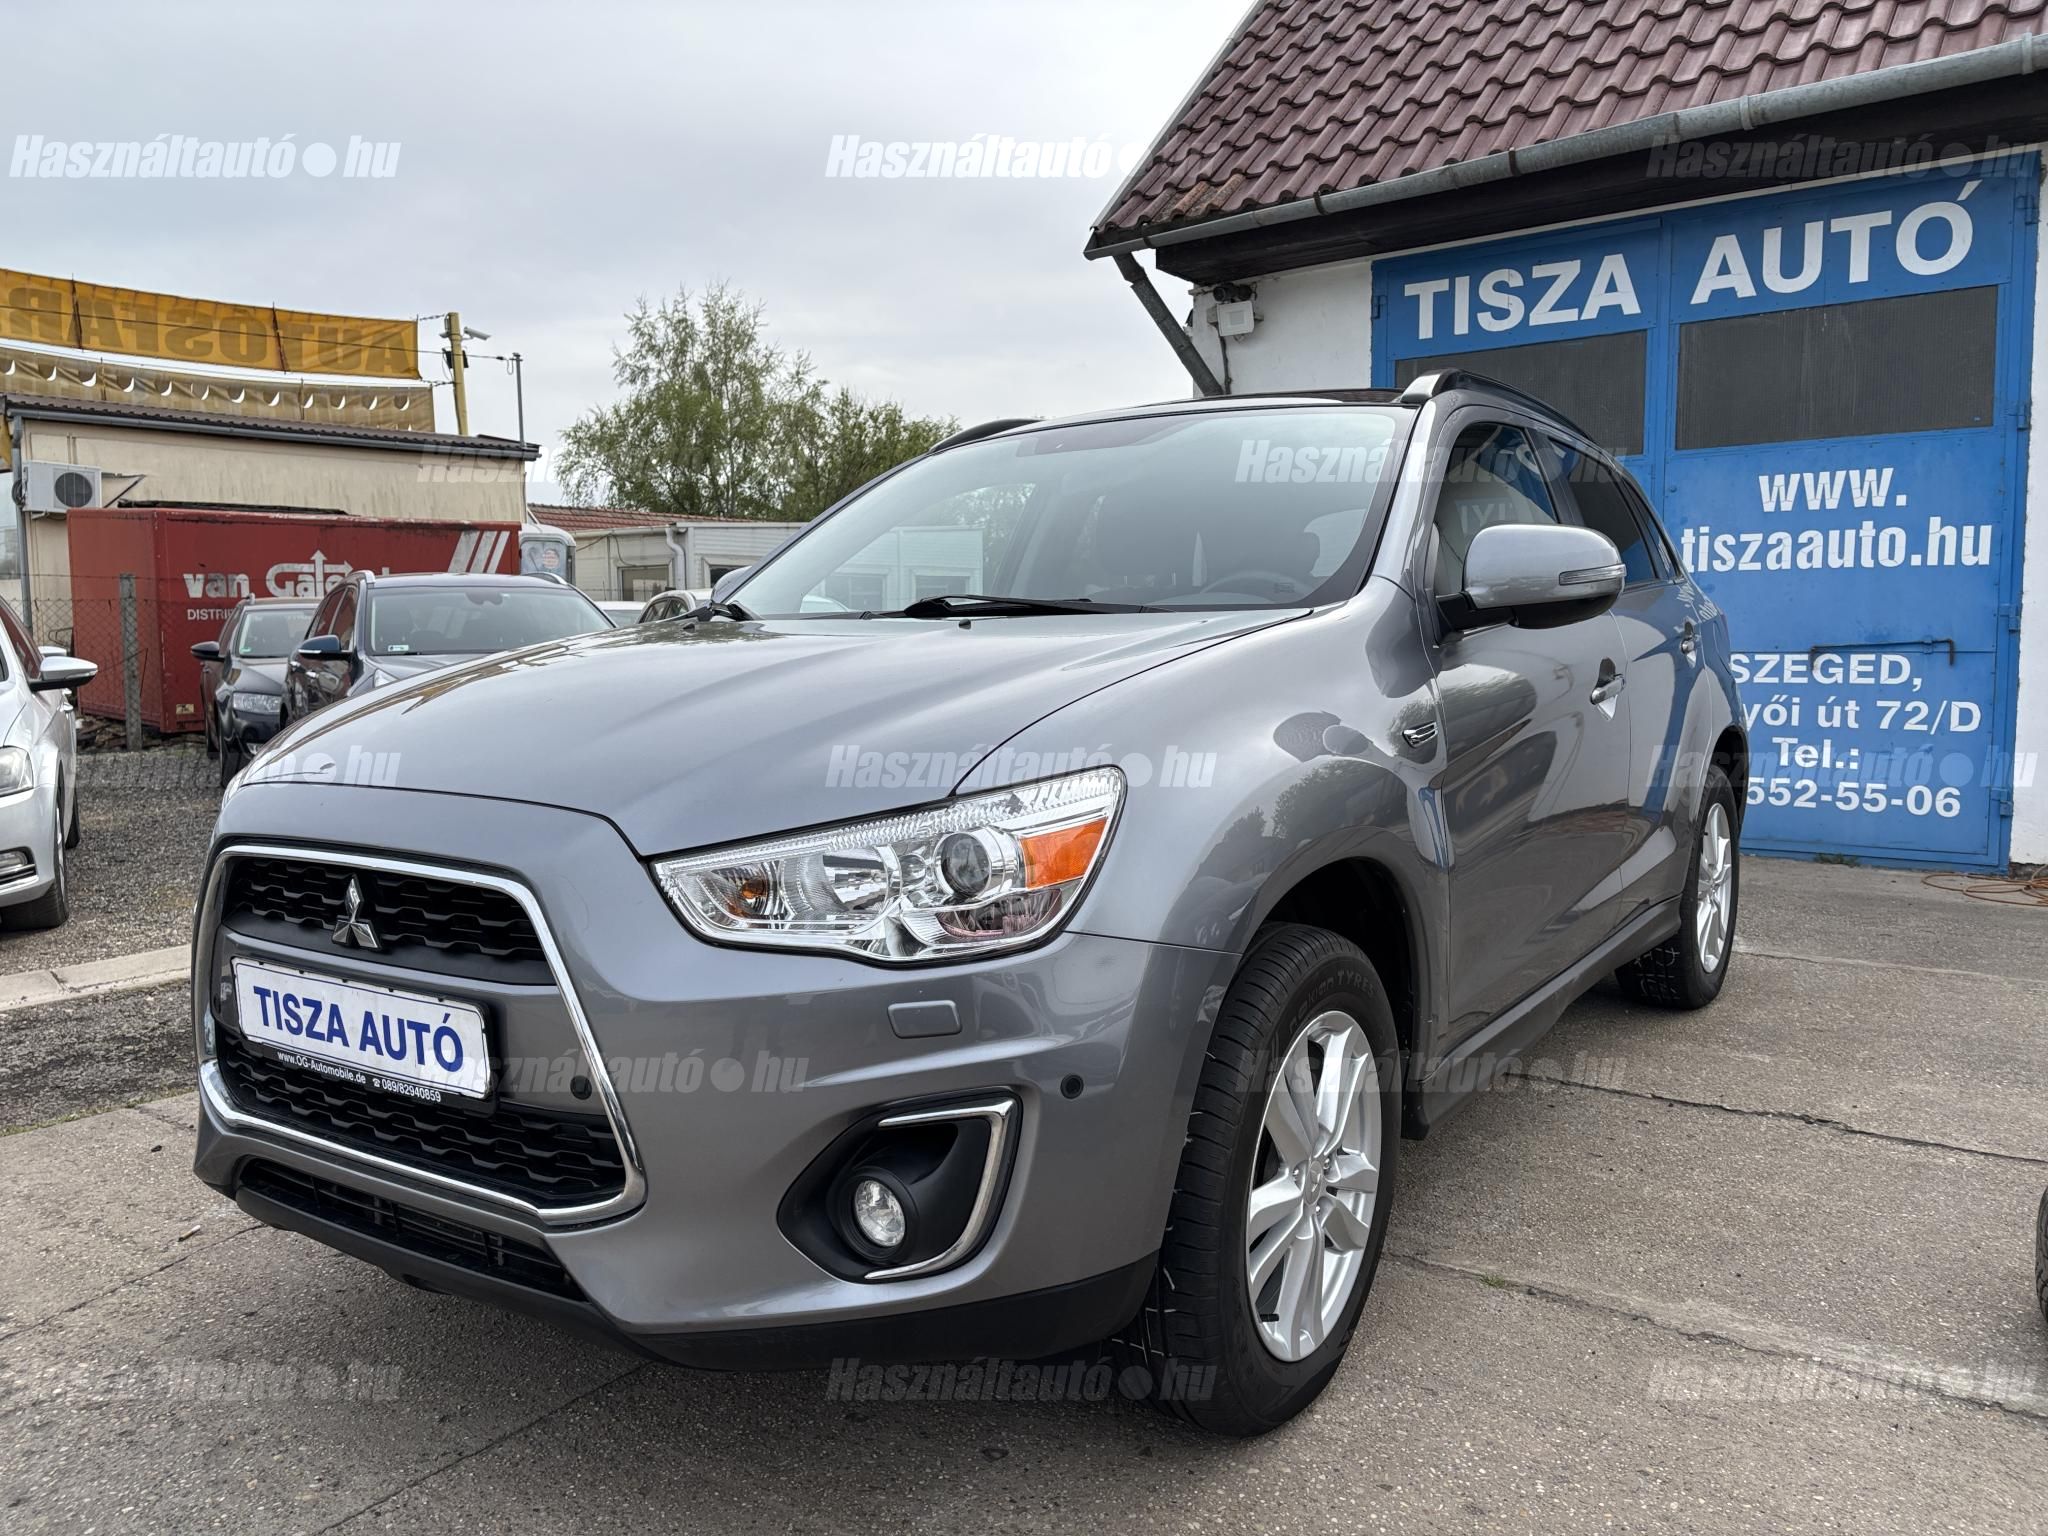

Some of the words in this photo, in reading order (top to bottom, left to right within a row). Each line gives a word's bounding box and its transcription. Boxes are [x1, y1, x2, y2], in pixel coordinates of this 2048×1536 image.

[1403, 253, 1642, 340] TISZA
[1690, 180, 1982, 305] AUTÓ
[1758, 467, 1908, 513] www.
[1681, 516, 1992, 572] tiszaauto.hu
[183, 573, 250, 598] van
[1729, 653, 1922, 692] SZEGED,
[1743, 694, 1800, 732] yői
[1817, 696, 1860, 728] út
[1876, 700, 1982, 735] 72/D
[1772, 737, 1859, 769] Tel.:
[1746, 777, 1961, 818] 552-55-06
[253, 985, 350, 1048] TISZA
[359, 1012, 464, 1073] AUTÓ
[277, 1051, 367, 1085] www.OG-Automobile.de
